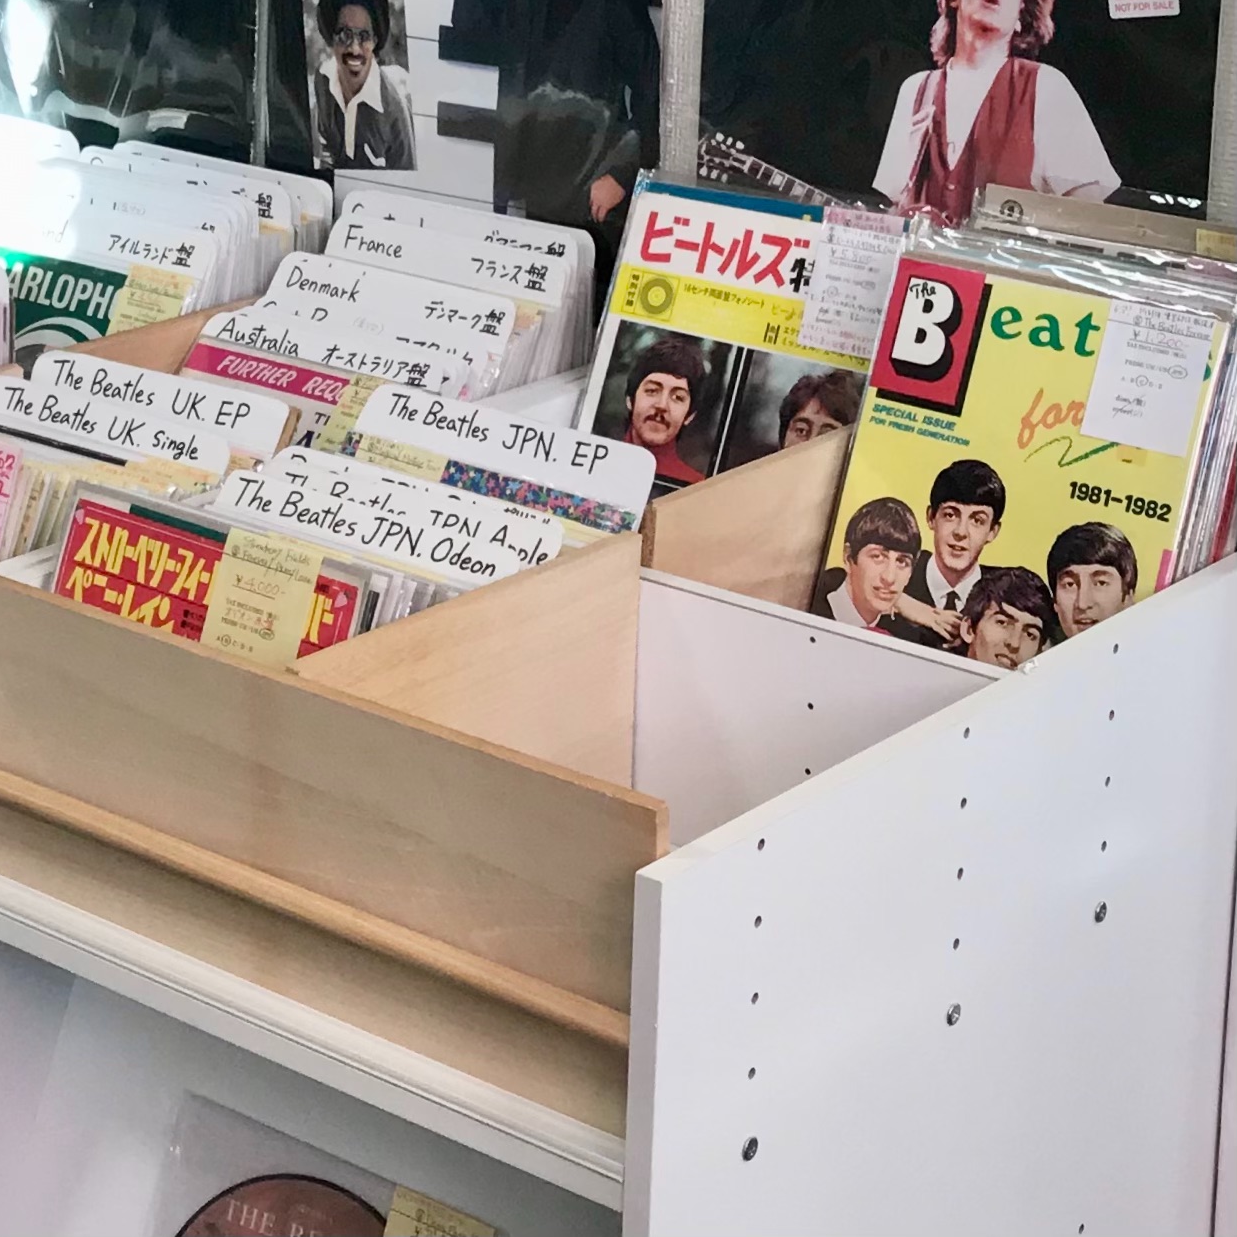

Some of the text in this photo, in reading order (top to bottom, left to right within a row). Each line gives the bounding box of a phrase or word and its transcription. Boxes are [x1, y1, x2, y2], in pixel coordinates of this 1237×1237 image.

[1114, 0, 1175, 13] NOT FOR SALE
[108, 233, 196, 269] アイルランド盤
[344, 224, 548, 293] France フランス盤
[640, 210, 813, 289] ビートルズ
[8, 262, 115, 320] ARLOPH
[286, 265, 507, 337] Denmark デンマーク盤
[909, 281, 938, 299] The
[216, 316, 431, 388] Australia オーストラリア盤
[892, 277, 1102, 384] Beat
[53, 359, 251, 430] The Beatles UK. EP
[216, 353, 299, 390] FURTHER
[4, 385, 33, 416] The
[31, 395, 97, 437] Beatles
[106, 415, 142, 449] UK.
[389, 393, 610, 476] The Beatles JPN. EP
[869, 415, 888, 426] FOR
[916, 427, 971, 447] GENERATION
[872, 403, 957, 432] SPECIAL ISSUE
[1016, 387, 1084, 450] for
[232, 476, 498, 580] The Beatles JPN. Odeon
[1068, 480, 1173, 524] 1981-1982
[225, 1198, 278, 1235] THE
